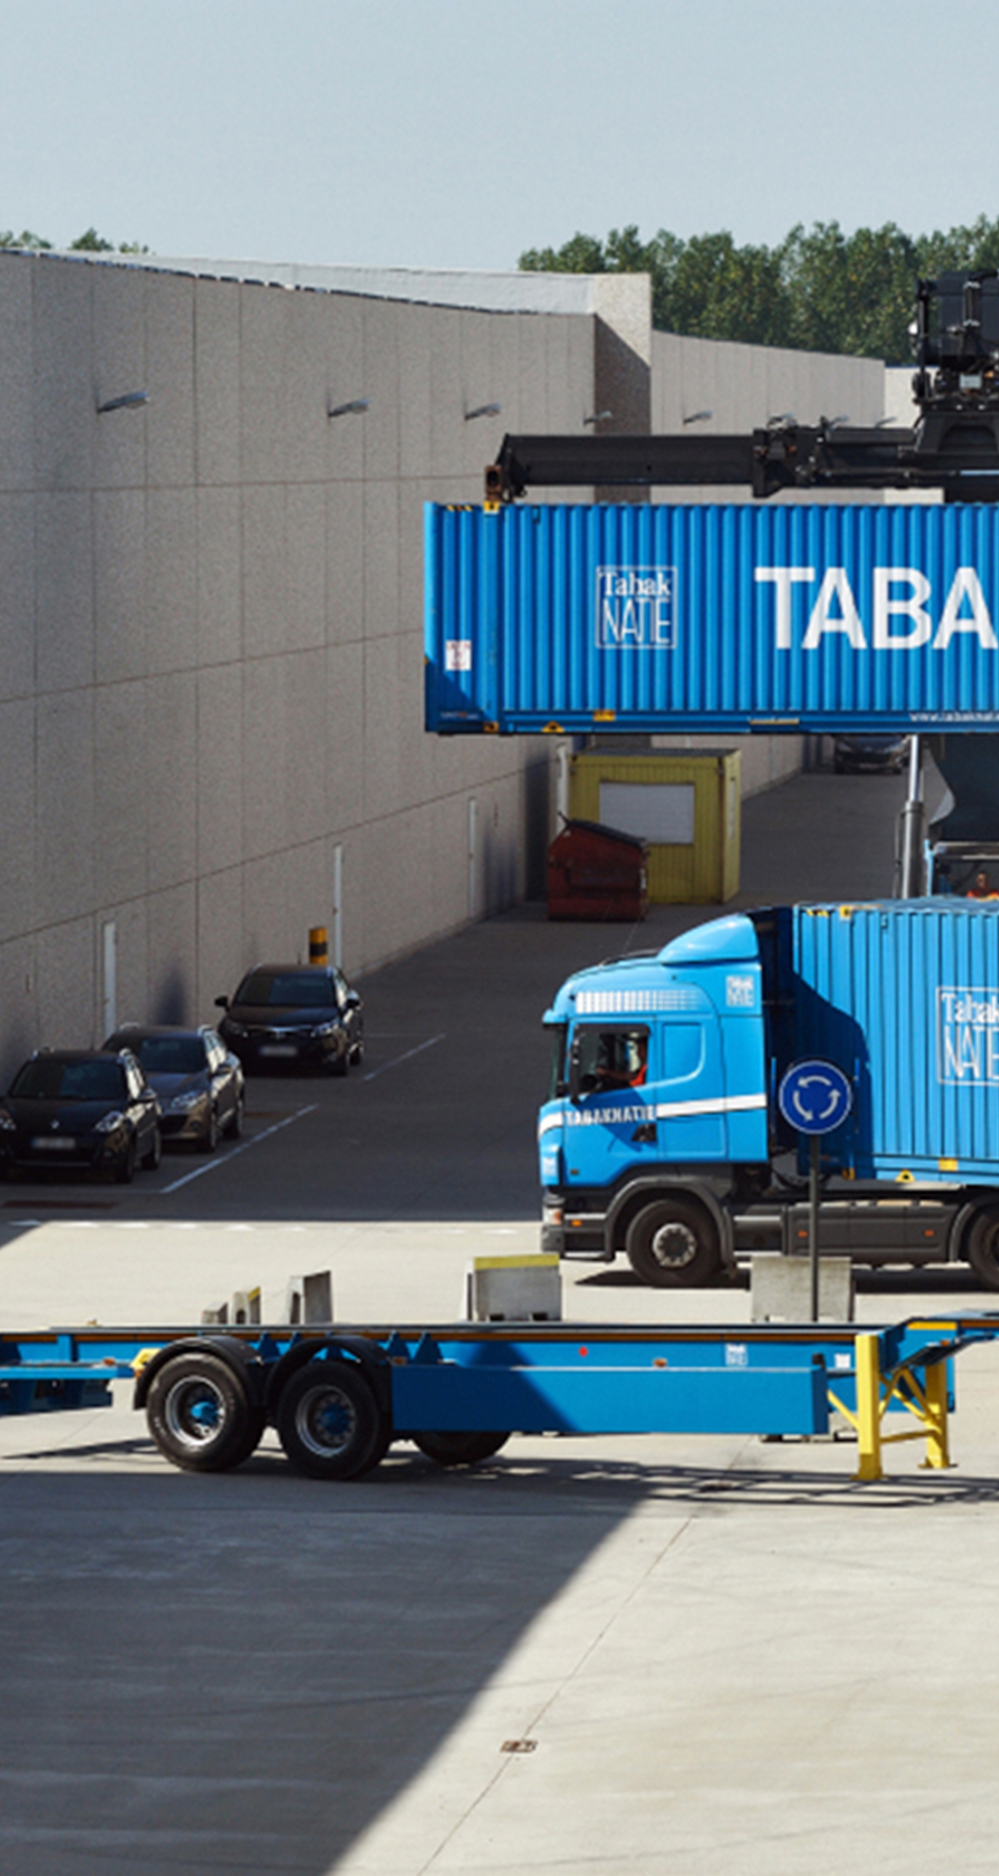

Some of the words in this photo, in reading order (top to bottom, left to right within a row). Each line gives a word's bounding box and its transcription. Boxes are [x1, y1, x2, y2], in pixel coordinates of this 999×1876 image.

[597, 571, 671, 596] Tabak
[602, 597, 671, 643] NATIE
[565, 1104, 656, 1126] TABAKNATIE
